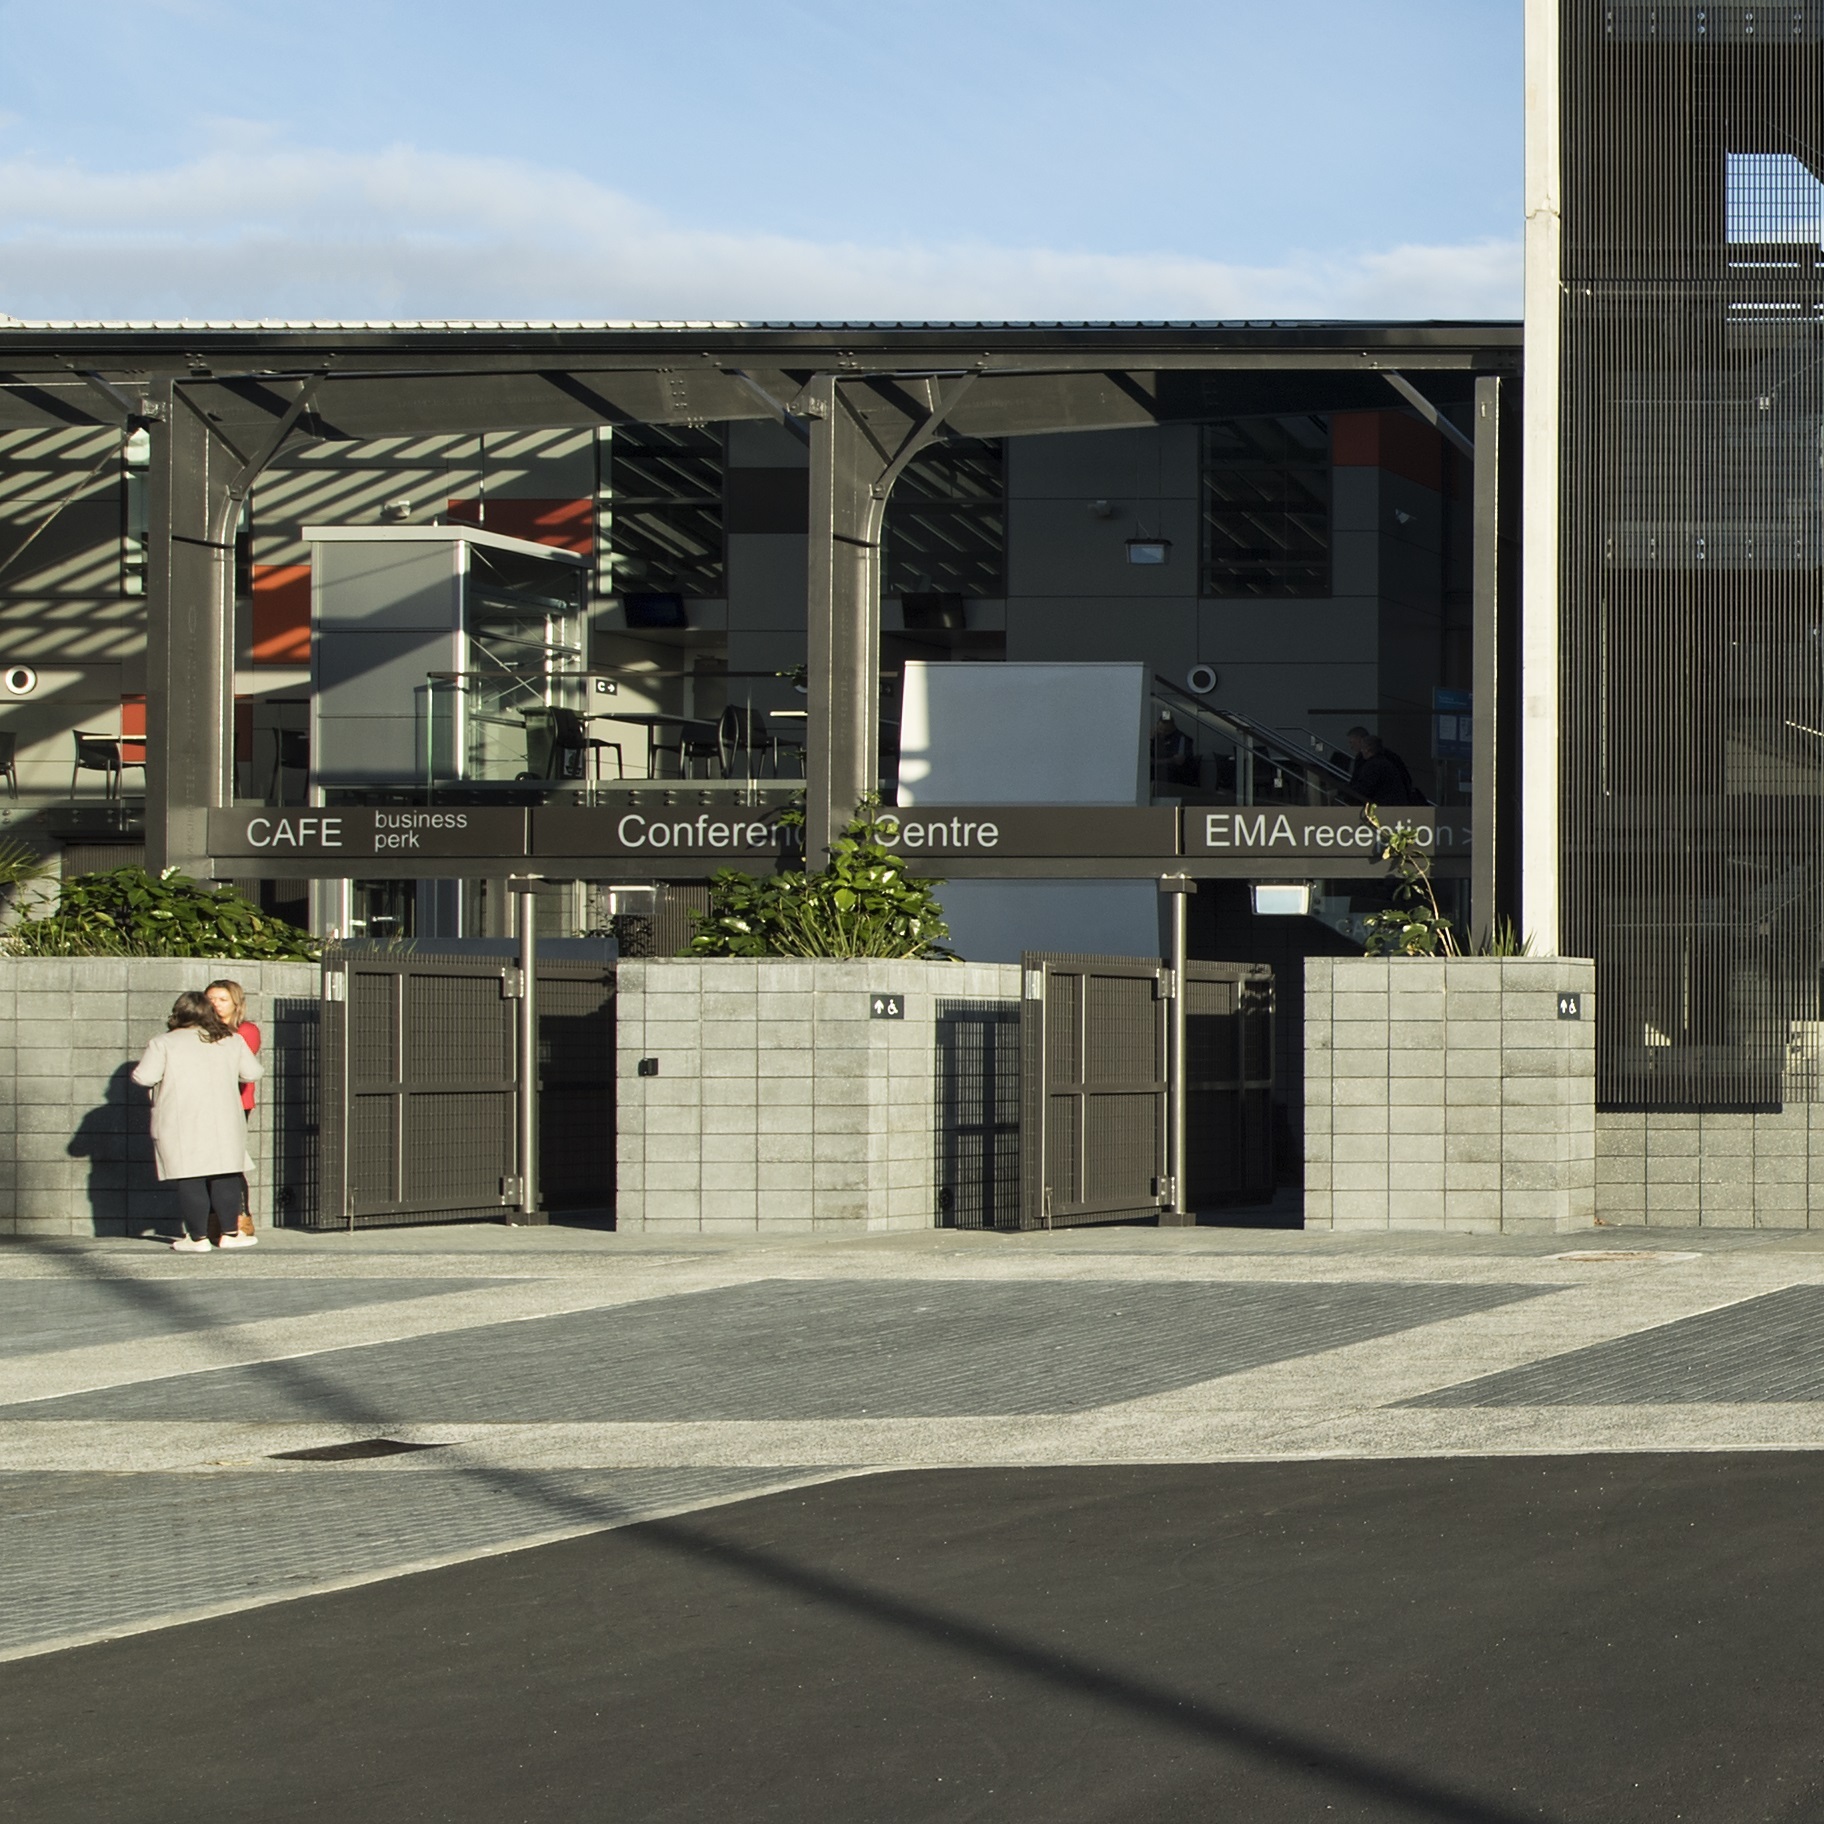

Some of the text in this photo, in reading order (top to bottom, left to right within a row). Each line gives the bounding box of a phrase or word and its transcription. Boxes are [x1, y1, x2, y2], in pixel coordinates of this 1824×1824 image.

[246, 817, 343, 848] CAFE
[374, 809, 469, 829] business
[874, 813, 1000, 849] Centre
[1205, 814, 1297, 847] EMA
[374, 829, 421, 852] perk
